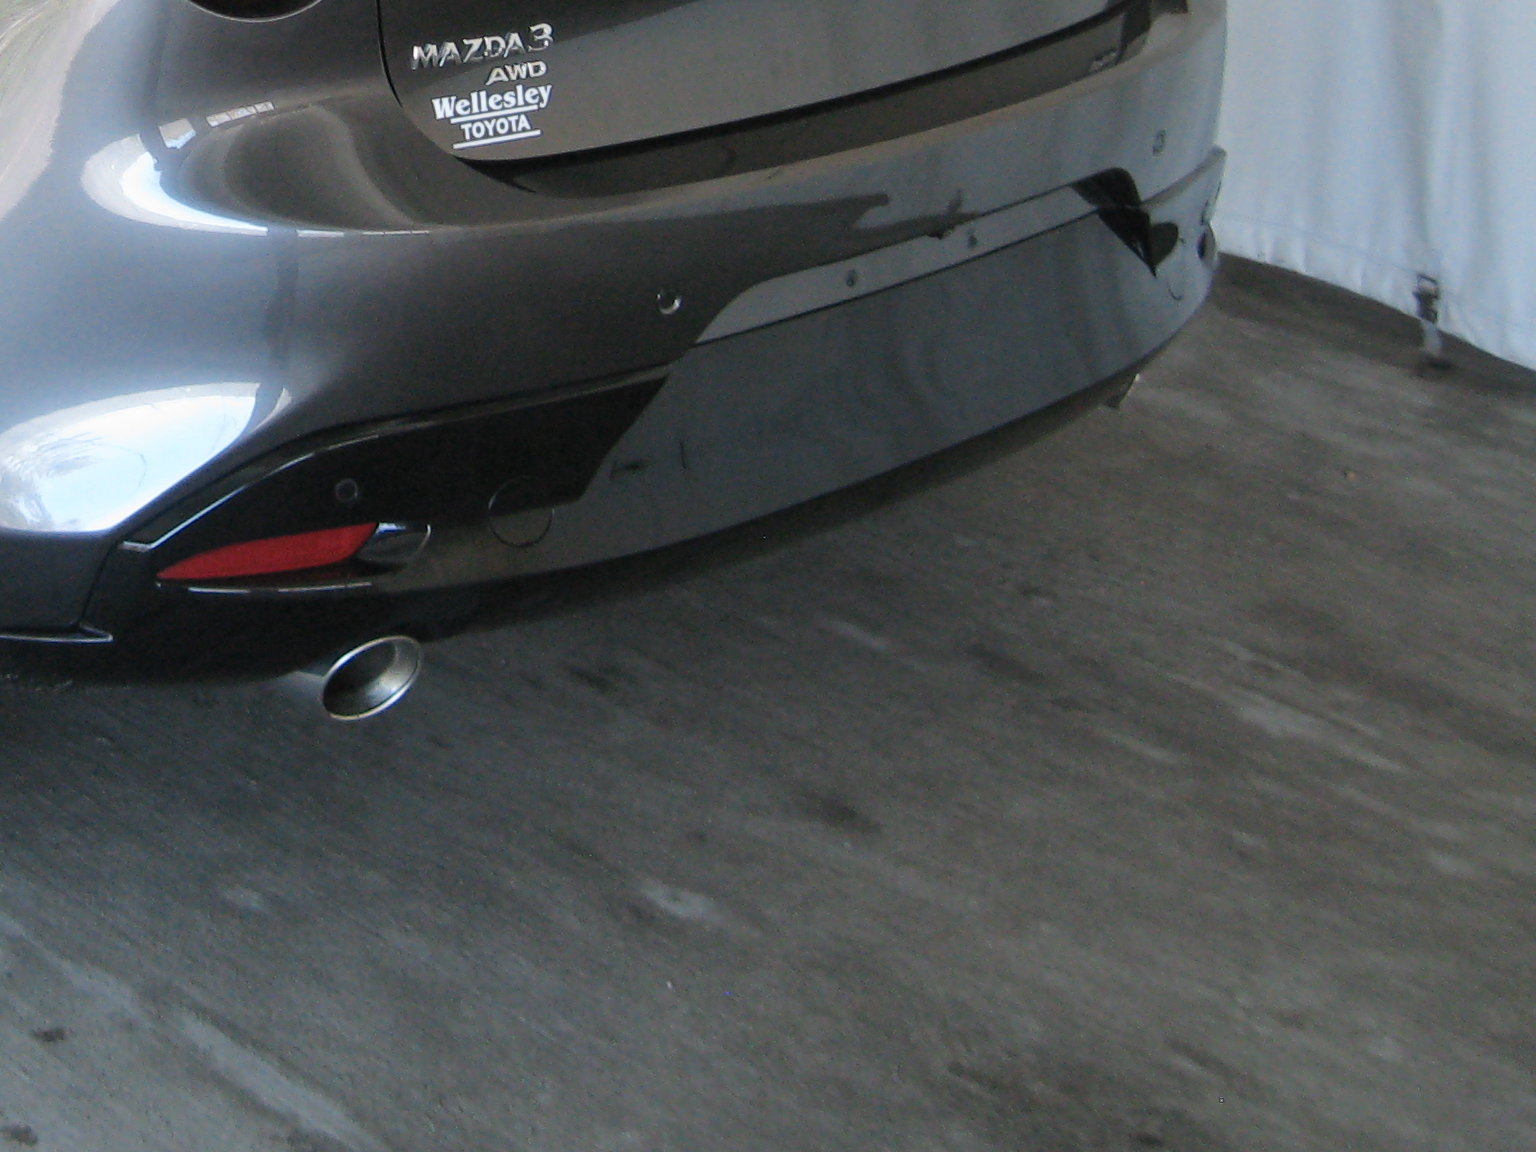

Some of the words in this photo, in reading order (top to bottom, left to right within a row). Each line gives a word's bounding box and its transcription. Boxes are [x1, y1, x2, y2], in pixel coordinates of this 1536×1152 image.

[485, 60, 547, 86] AWD
[431, 84, 553, 120] Wellesley
[460, 114, 532, 140] TOYOTA
